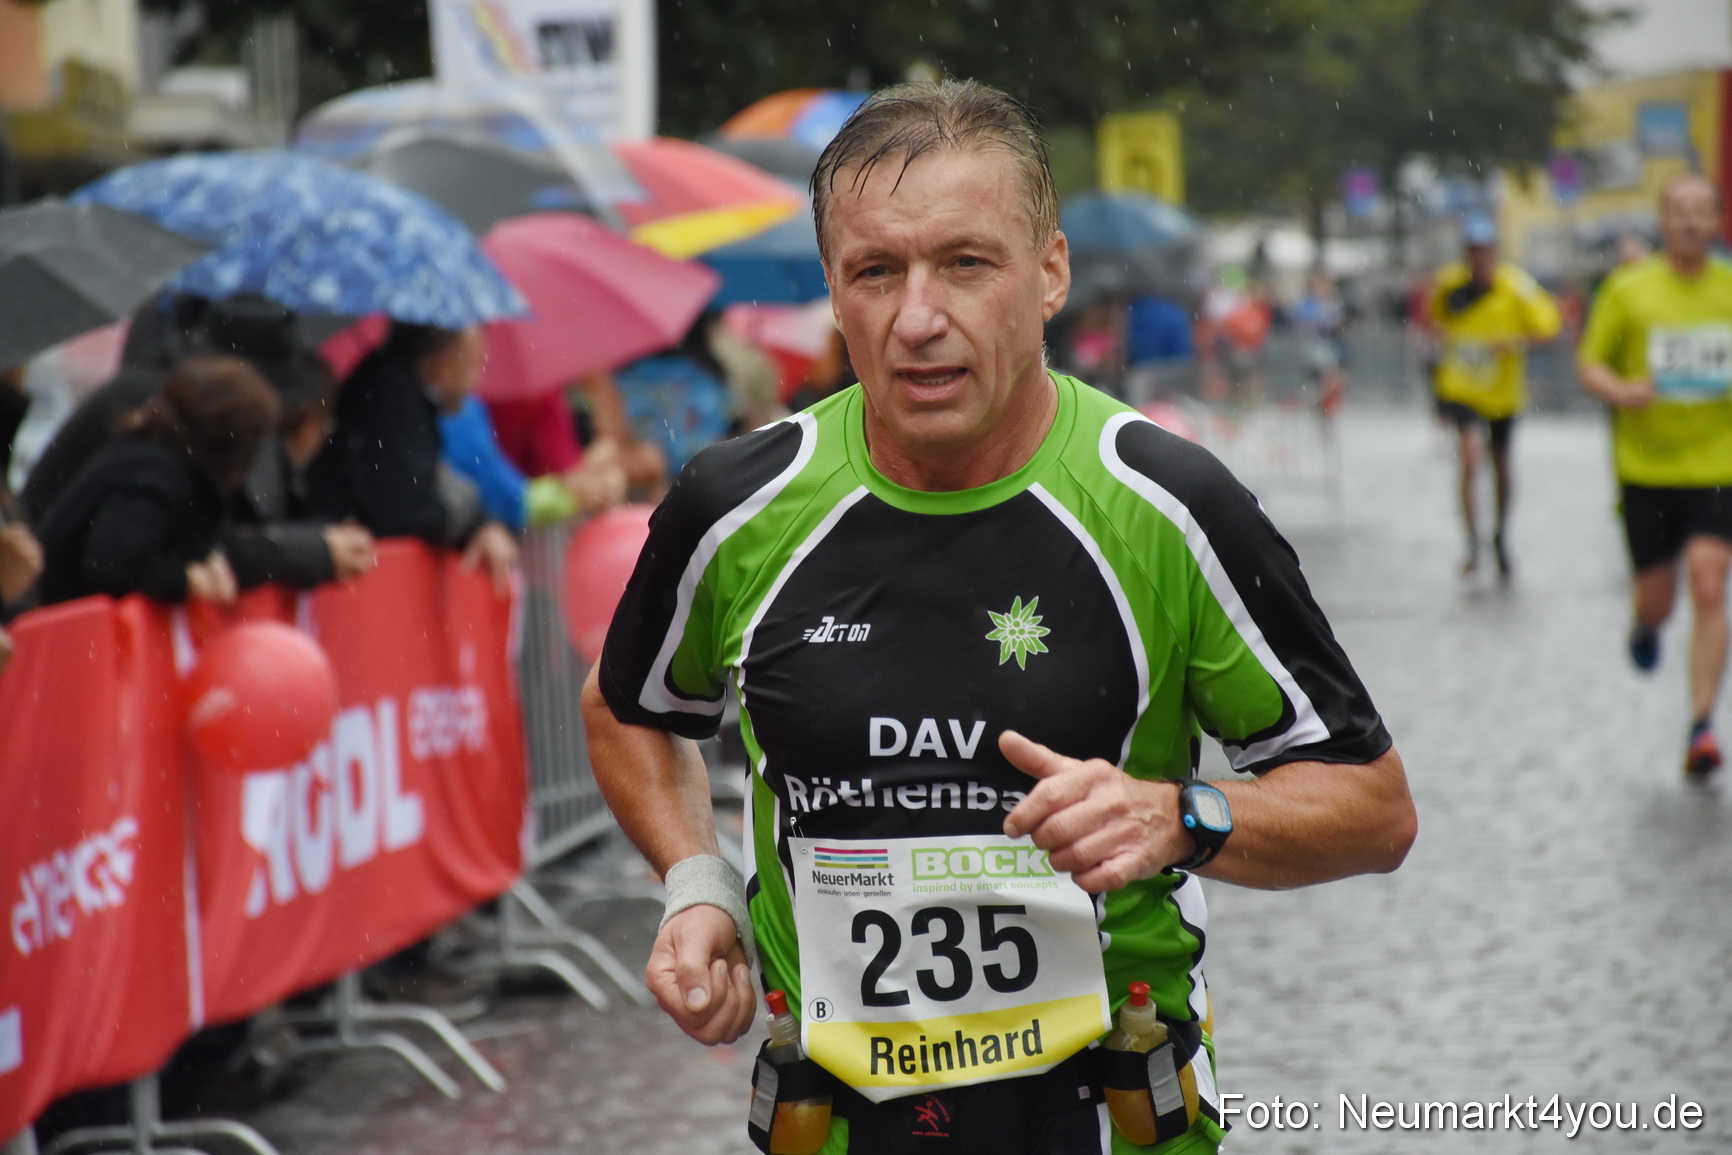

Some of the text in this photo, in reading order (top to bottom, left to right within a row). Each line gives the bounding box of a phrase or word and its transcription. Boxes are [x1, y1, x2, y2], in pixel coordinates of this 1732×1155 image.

[868, 717, 987, 760] DAV
[911, 845, 1056, 881] BOCK
[863, 890, 892, 898] genießen
[912, 878, 1059, 895] inspired by smart concepts
[851, 904, 1039, 1008] 235
[870, 1019, 1044, 1076] Reinhard
